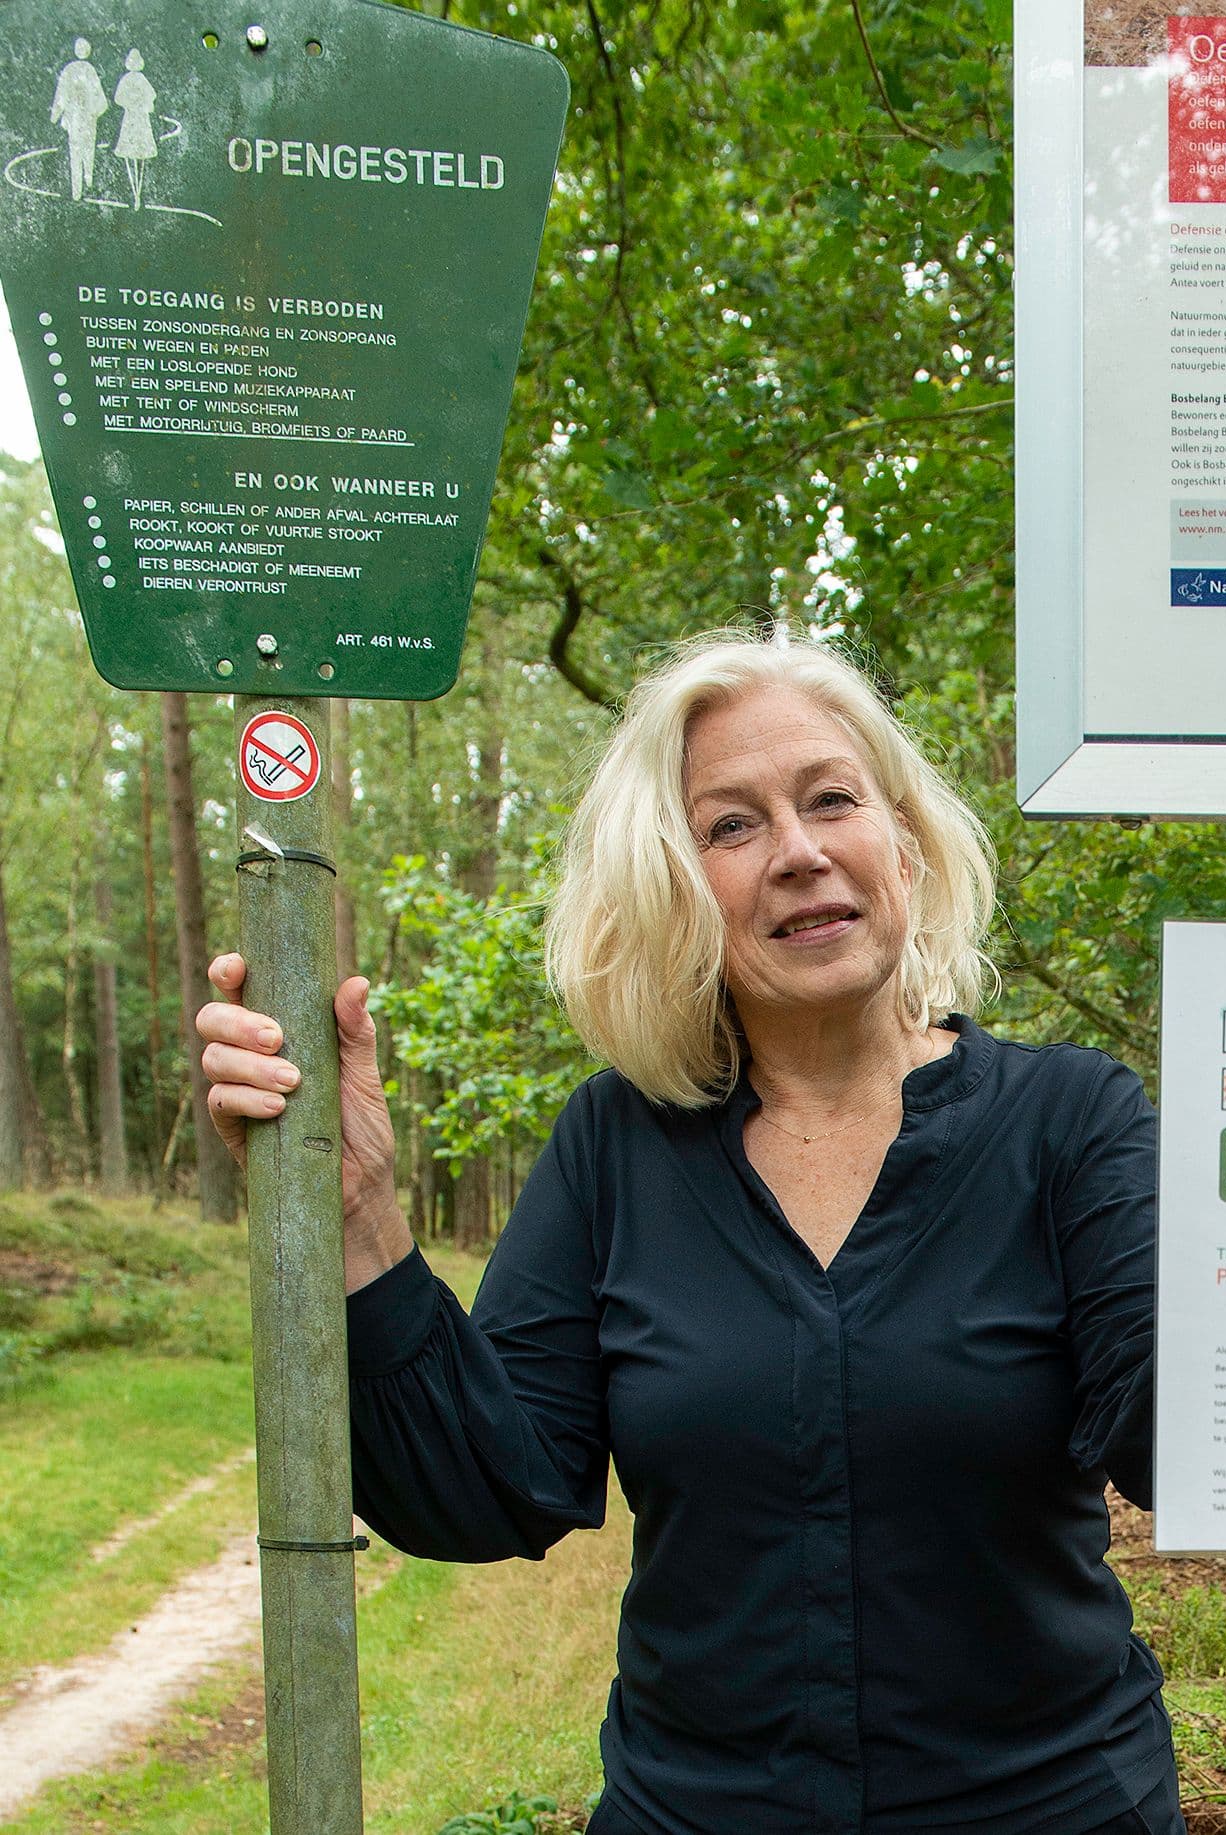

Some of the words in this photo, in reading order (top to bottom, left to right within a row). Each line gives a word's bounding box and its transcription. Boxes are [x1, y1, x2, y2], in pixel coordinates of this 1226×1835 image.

[228, 137, 505, 190] OPENGESTELD
[1170, 222, 1222, 236] Defensie
[1169, 277, 1198, 288] Antea
[1198, 279, 1224, 288] voert
[78, 285, 107, 303] DE
[118, 287, 224, 310] TOEGANG
[235, 295, 256, 312] IS
[267, 297, 383, 320] VERBODEN
[79, 315, 137, 331] TUSSEN
[142, 319, 270, 338] ZONSONDERGANG
[274, 326, 294, 340] EN
[299, 328, 396, 346] ZONSOPGANG
[85, 335, 137, 350] BUITEN
[142, 338, 194, 354] WEGEN
[199, 341, 218, 355] EN
[223, 343, 269, 358] PADEN
[90, 355, 121, 369] MET
[126, 357, 155, 373] EEN
[159, 358, 252, 376] LOSLOPENDE
[257, 364, 298, 379] HOND
[94, 374, 126, 388] MET
[130, 376, 159, 390] EEN
[164, 378, 228, 394] SPELEND
[233, 382, 356, 401] MUZIEKAPPARAAT
[1170, 392, 1221, 406] Bosbelang
[99, 394, 130, 408] MET
[135, 396, 172, 410] TENT
[178, 398, 198, 412] OF
[203, 399, 299, 417] WINDSCHERM
[104, 414, 134, 429] MET
[139, 416, 248, 436] MOTORRIJTUIG,
[250, 421, 331, 439] BROMFIETS
[335, 425, 356, 439] OF
[360, 427, 407, 442] PAARD
[1170, 426, 1219, 439] Bosbelang
[234, 471, 262, 489] EN
[273, 473, 319, 492] OOK
[330, 476, 434, 497] WANNEER
[445, 482, 459, 499] U
[1170, 475, 1221, 489] ongeschikt
[123, 498, 175, 514] PAPIER,
[179, 500, 245, 516] SCHILLEN
[249, 504, 270, 517] OF
[274, 505, 321, 520] ANDER
[326, 508, 368, 522] AFVAL
[371, 510, 459, 527] ACHTERLAAT
[1178, 507, 1200, 518] Lees
[1201, 507, 1217, 518] het
[129, 517, 182, 534] ROOKT,
[186, 520, 235, 535] KOOKT
[240, 523, 260, 536] OF
[264, 524, 323, 539] VUURTJE
[327, 527, 383, 542] STOOKT
[133, 537, 213, 553] KOOPWAAR
[218, 541, 285, 556] AANBIEDT
[138, 556, 169, 570] IETS
[172, 558, 260, 574] BESCHADIGT
[264, 562, 284, 575] OF
[288, 563, 362, 579] MEENEEMT
[142, 576, 193, 590] DIEREN
[196, 578, 288, 594] VERONTRUST
[335, 633, 365, 646] ART.
[369, 634, 392, 648] 461
[396, 635, 436, 649] W.v.S.
